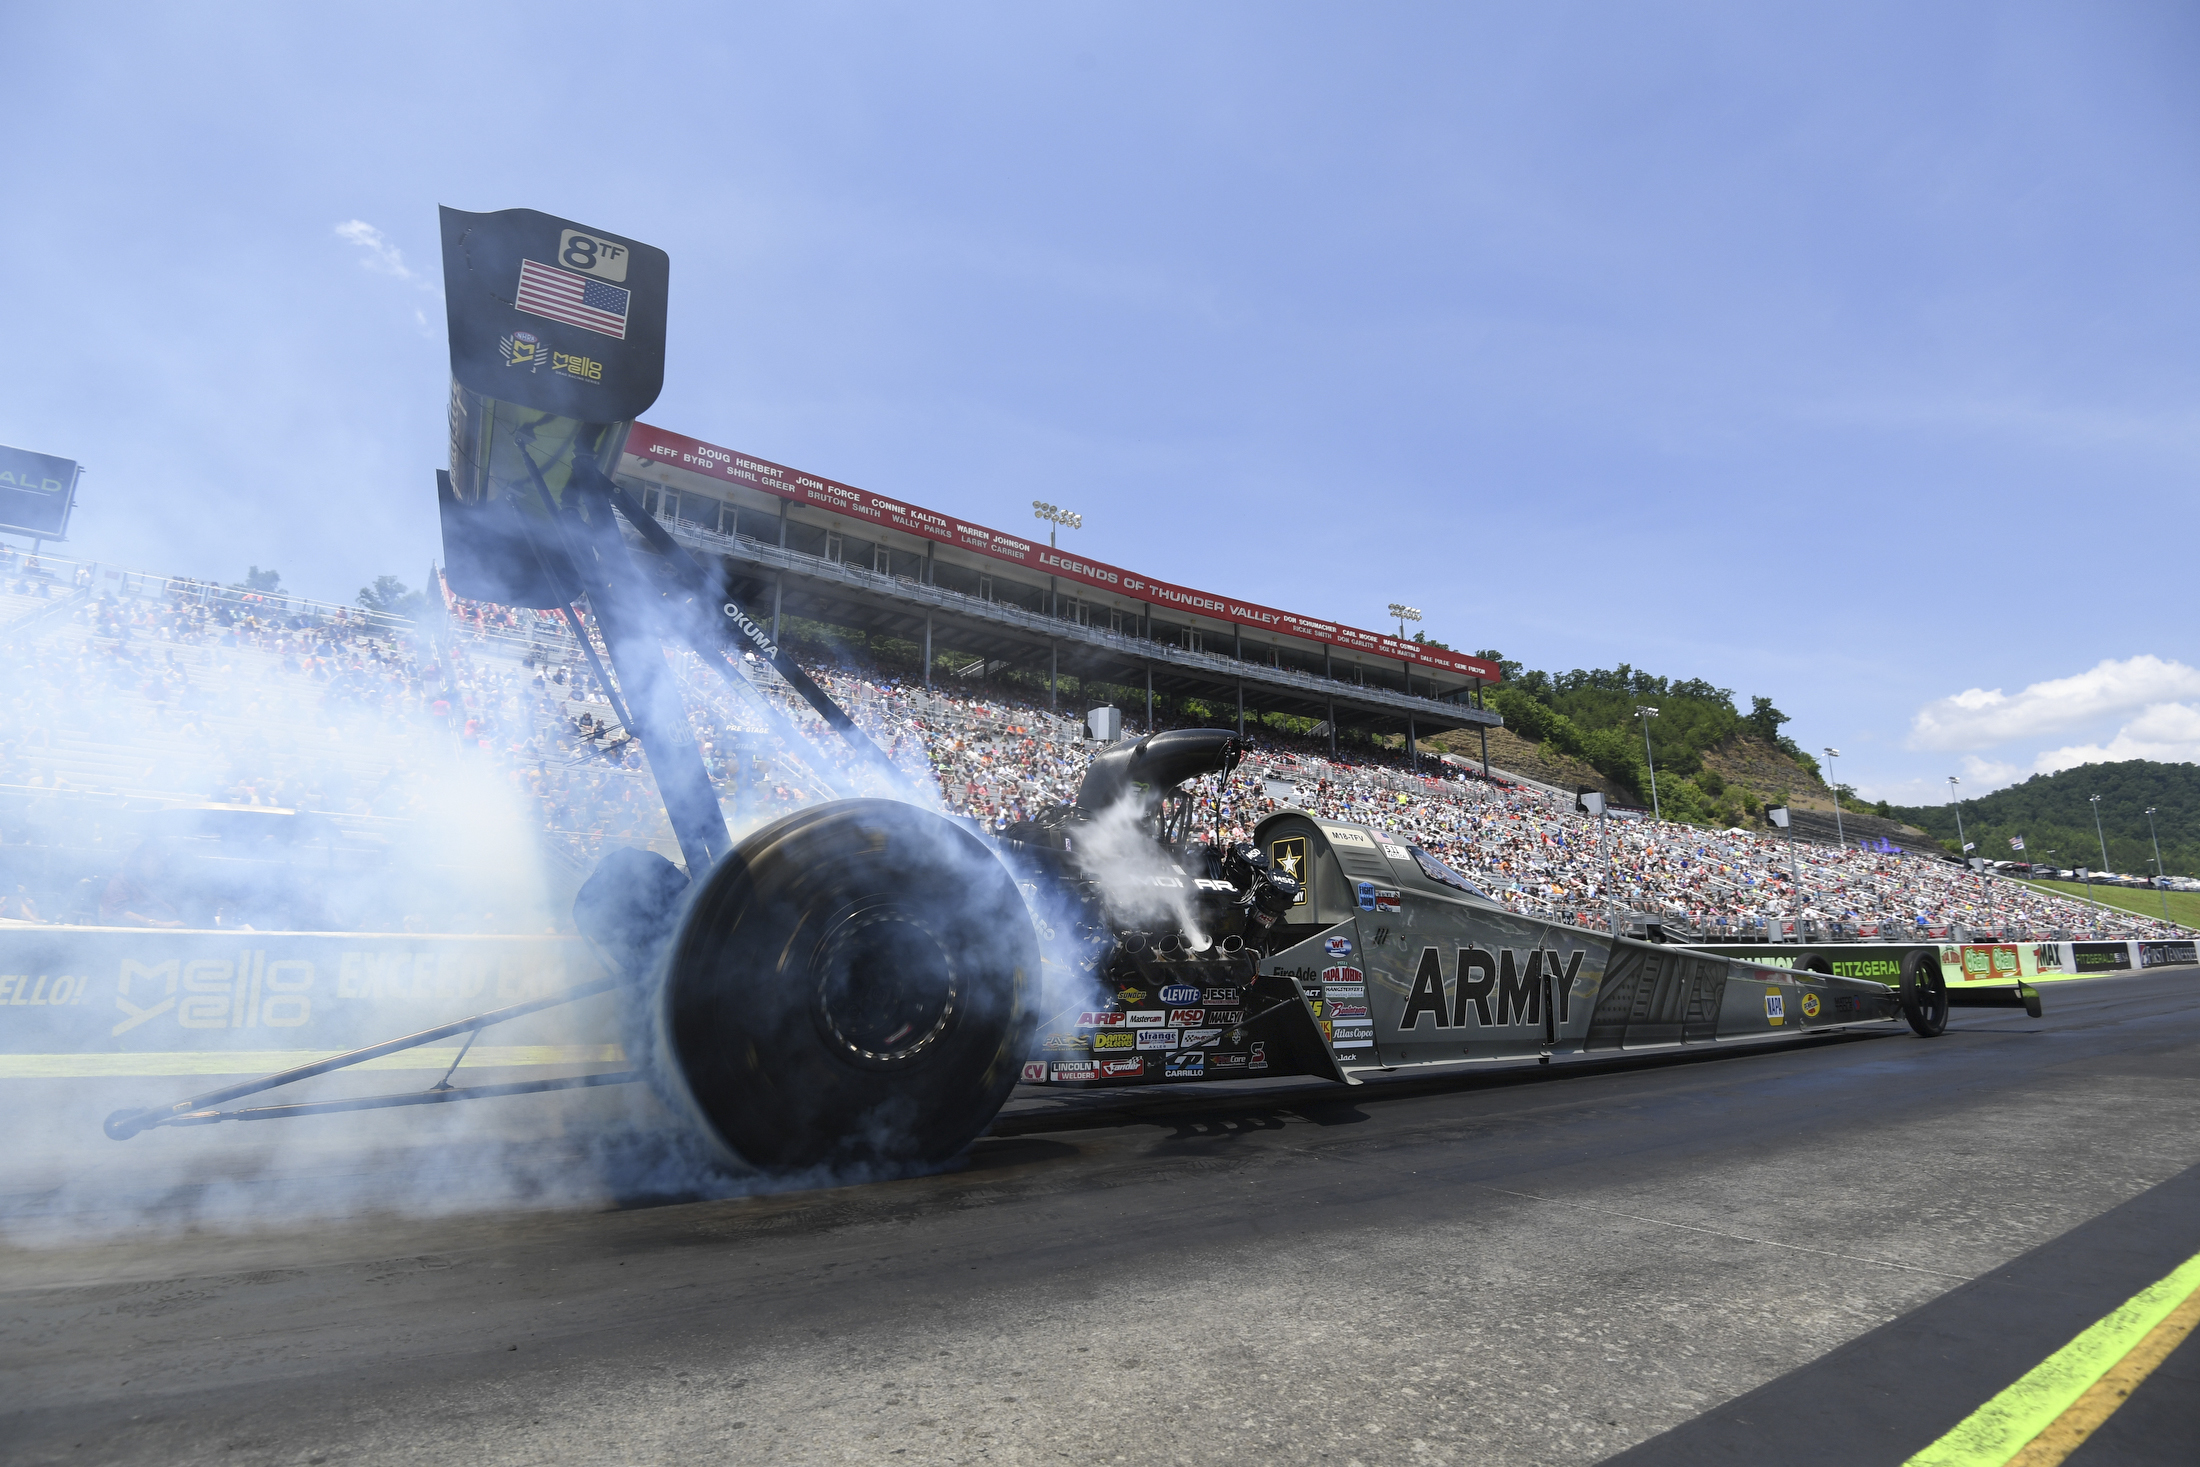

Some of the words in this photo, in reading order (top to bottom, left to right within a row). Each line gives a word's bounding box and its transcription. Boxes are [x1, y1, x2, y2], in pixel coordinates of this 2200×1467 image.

[563, 236, 598, 270] 8
[599, 242, 625, 260] TF
[649, 445, 678, 458] JEFF
[683, 453, 713, 469] BYRD
[698, 446, 730, 463] DOUG
[736, 458, 784, 478] HERBERT
[726, 467, 757, 482] SHIRL
[761, 476, 796, 493] GREER
[795, 476, 823, 491] JOHN
[828, 485, 860, 502] FORCE
[807, 490, 847, 508] BRUTON
[852, 503, 881, 518] SMITH
[871, 498, 906, 515] CONNIE
[910, 510, 947, 527] KALITTA
[892, 514, 920, 529] WALLY
[924, 524, 952, 538] PARKS
[956, 524, 989, 540] WARREN
[992, 535, 1030, 552] JOHNSON
[961, 535, 987, 549] LARRY
[991, 544, 1025, 560] CARRIER
[1039, 552, 1118, 584] LEGENDS
[1123, 577, 1145, 591] OF
[1149, 585, 1225, 613] THUNDER
[1229, 605, 1281, 625] VALLEY
[723, 603, 779, 660] OKUMA
[1283, 615, 1297, 624] DON
[1299, 619, 1337, 633] SCHUMACHER
[1315, 630, 1332, 639] SMITH
[1332, 831, 1364, 842] M18-TFV
[1273, 875, 1296, 885] MSD
[117, 951, 314, 998] Mello
[337, 951, 487, 999] EXCEED
[1322, 968, 1340, 982] PAPA
[1832, 961, 1901, 977] FITZGERAL
[1118, 991, 1146, 999] SUNOCO
[1160, 985, 1199, 1002] CLEVITE
[1203, 988, 1239, 1000] JESEL
[1302, 989, 1320, 997] ACT
[1398, 946, 1587, 1031] ARMY
[1767, 997, 1783, 1016] NAPA
[112, 993, 312, 1038] Yello
[1077, 1013, 1125, 1024] ARP
[1129, 1015, 1162, 1023] Mastercam
[1171, 1009, 1203, 1022] MSD
[1209, 1011, 1241, 1024] MANLEY
[1138, 1031, 1176, 1041] Strange
[1333, 1028, 1353, 1039] Atlas
[1354, 1028, 1374, 1039] Copco
[1024, 1065, 1043, 1079] CV
[1053, 1063, 1092, 1072] LINCOLN
[1061, 1072, 1095, 1080] WELDERS
[1165, 1069, 1204, 1078] CARRILLO
